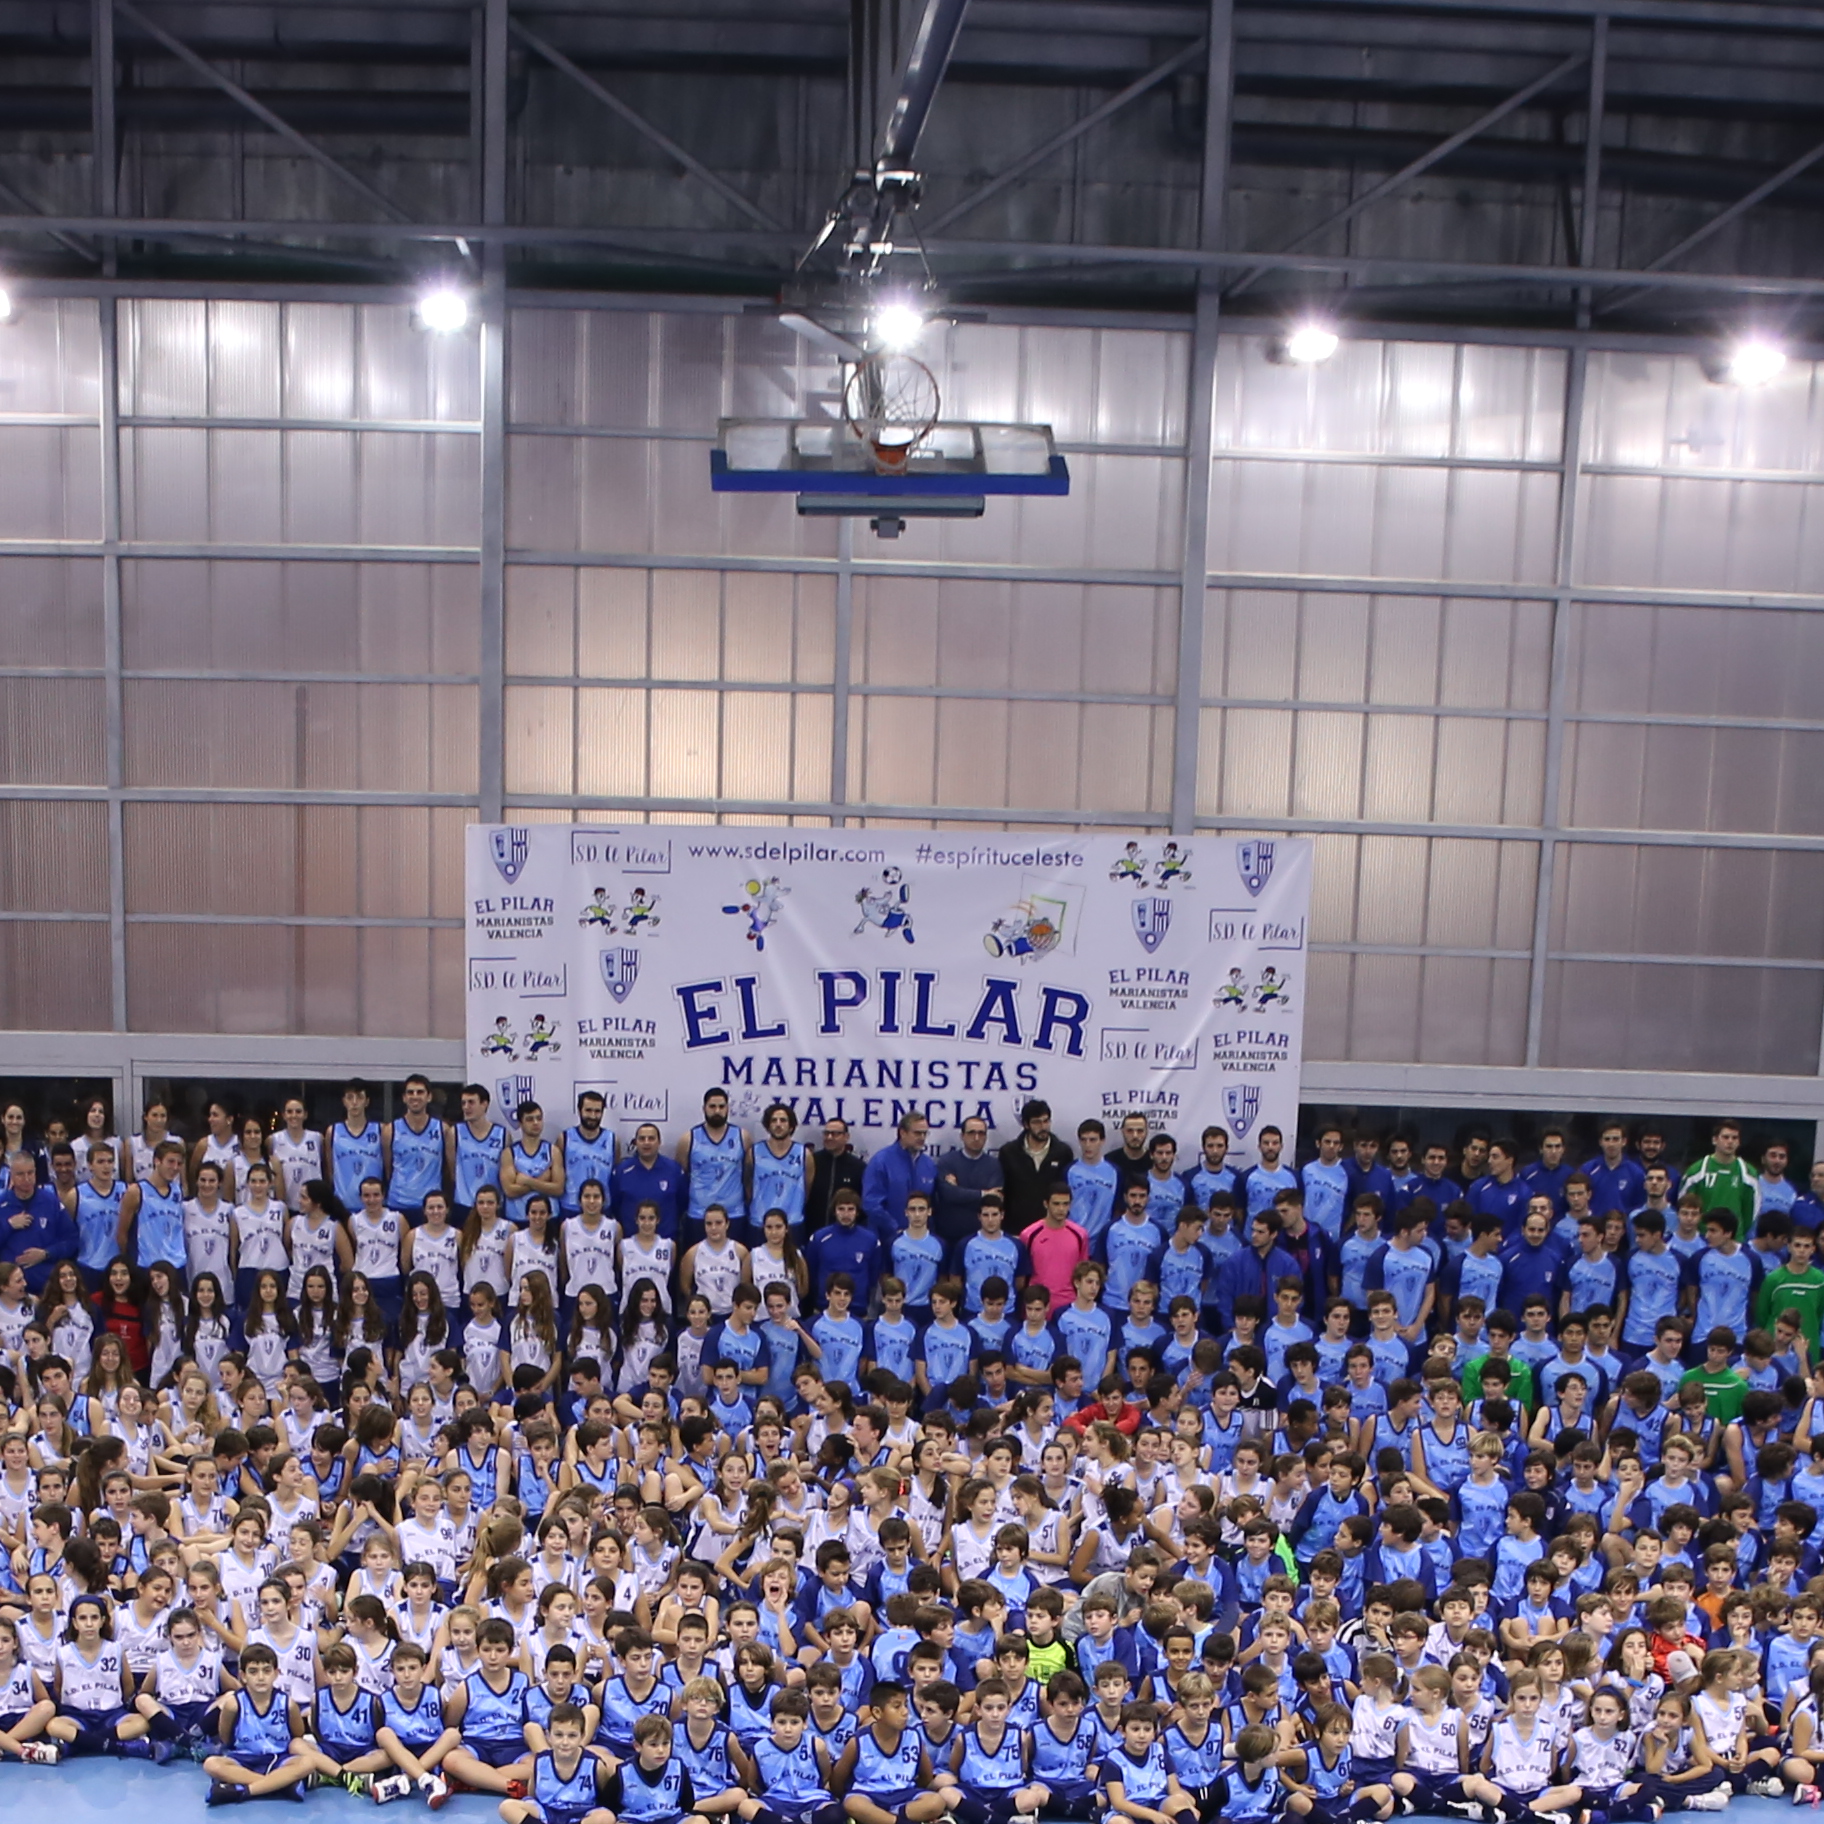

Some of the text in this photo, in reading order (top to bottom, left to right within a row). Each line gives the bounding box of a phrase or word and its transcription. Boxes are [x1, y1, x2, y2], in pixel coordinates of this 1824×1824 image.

[626, 845, 668, 865] Pilar
[688, 842, 885, 865] www.sdelpilar.com
[915, 844, 1084, 869] #espírituceleste
[475, 897, 554, 914] EL PILAR
[476, 917, 554, 928] MARIANISTAS
[487, 929, 543, 939] VALENCIA
[1262, 923, 1299, 940] Pilar
[523, 970, 563, 989] Pilar
[1109, 967, 1190, 985] EL PILAR
[1109, 987, 1188, 998] MARIANISTAS
[1121, 1000, 1177, 1010] VALENCIA
[674, 969, 1090, 1058] EL PILAR
[578, 1017, 656, 1034] EL PILAR
[579, 1038, 656, 1047] MARIANISTAS
[1214, 1030, 1289, 1048] EL PILAR
[590, 1050, 644, 1059] VALENCIA
[1155, 1043, 1194, 1060] Pilar
[1213, 1051, 1288, 1060] MARIANISTAS
[722, 1056, 1038, 1091] MARIANISTAS
[1222, 1063, 1276, 1072] VALENCIA
[623, 1093, 665, 1111] Pilar
[1102, 1090, 1179, 1106] EL PILAR
[428, 1130, 439, 1140] 14
[789, 1155, 801, 1166] 24
[1705, 1172, 1717, 1188] 17
[600, 1230, 612, 1241] 64
[440, 1527, 452, 1540] 96
[624, 1587, 630, 1600] 4
[295, 1646, 311, 1661] 30
[101, 1657, 118, 1672] 32
[199, 1665, 213, 1679] 31
[12, 1680, 29, 1694] 34
[271, 1710, 286, 1725] 25
[352, 1710, 368, 1724] 41
[425, 1702, 439, 1718] 18
[1441, 1723, 1455, 1736] 50
[1470, 1714, 1487, 1730] 55
[902, 1747, 919, 1763] 53
[1206, 1740, 1221, 1756] 97
[580, 1775, 592, 1791] 74
[664, 1775, 680, 1789] 67
